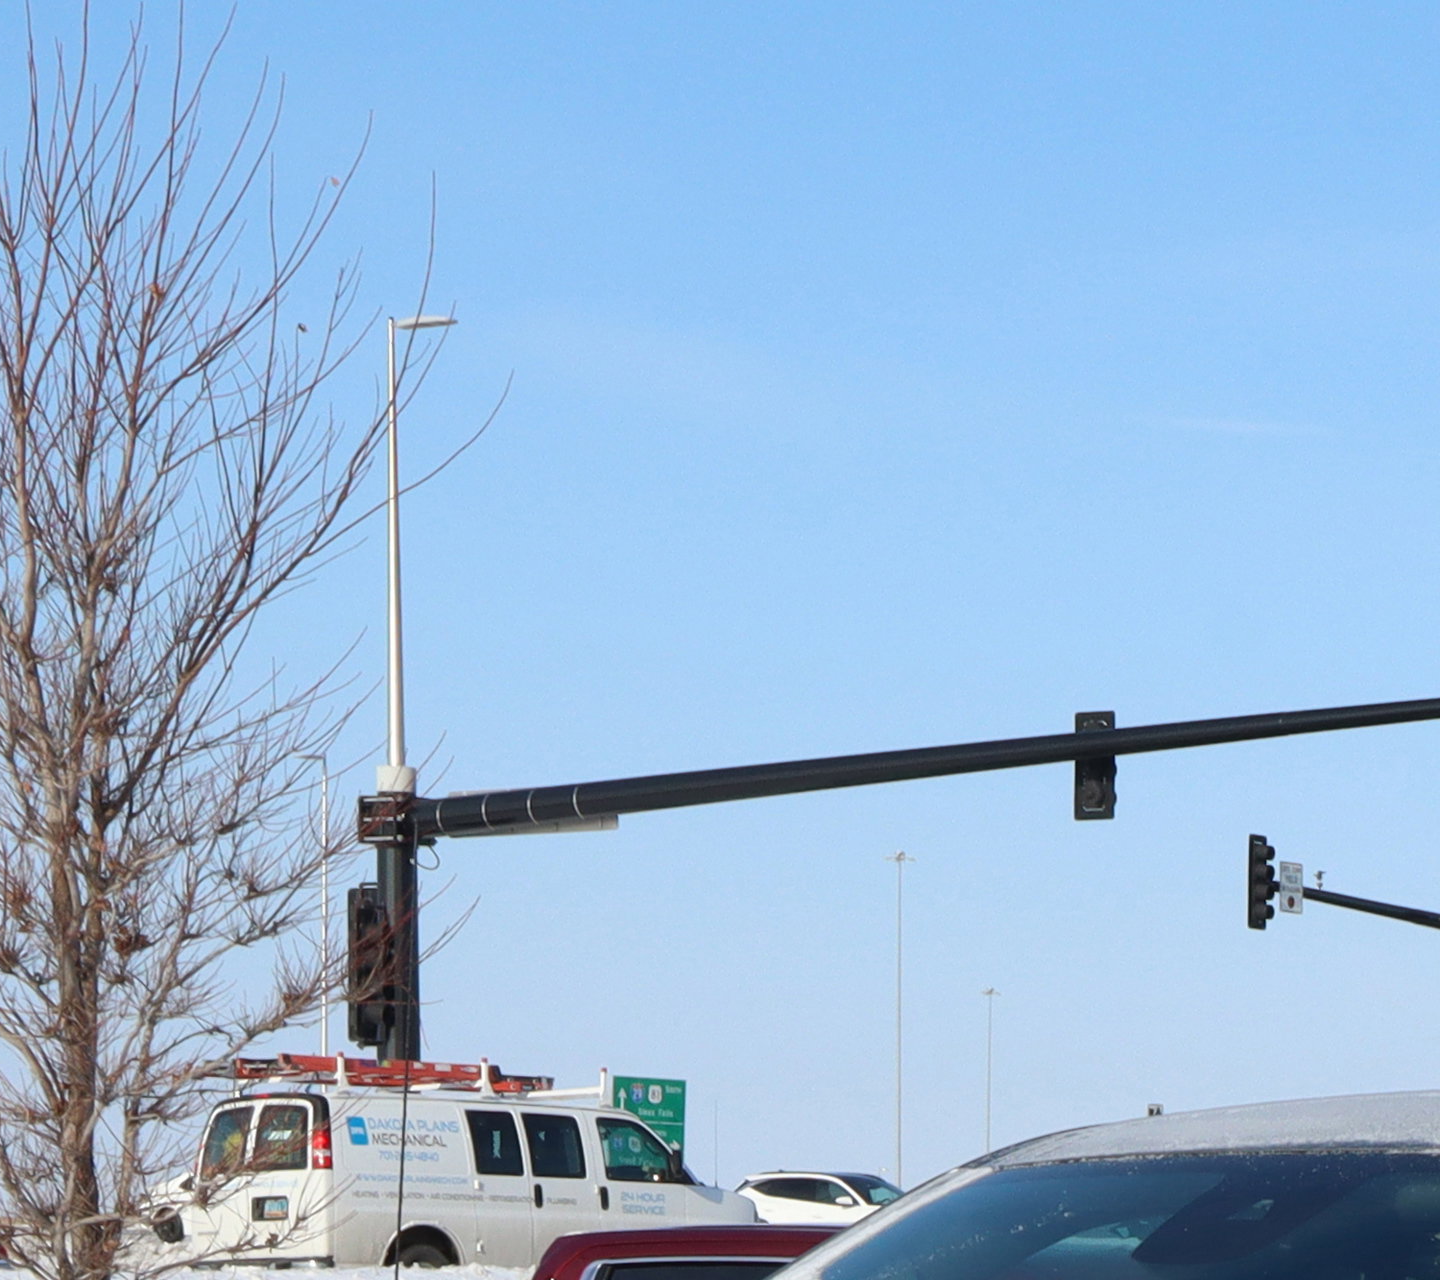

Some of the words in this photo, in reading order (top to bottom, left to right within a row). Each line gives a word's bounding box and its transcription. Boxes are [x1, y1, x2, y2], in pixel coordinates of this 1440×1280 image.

[367, 1118, 416, 1131] DAKOA
[417, 1119, 460, 1134] PLAINS
[636, 1192, 665, 1203] HOUR
[623, 1203, 665, 1215] SERVICE
